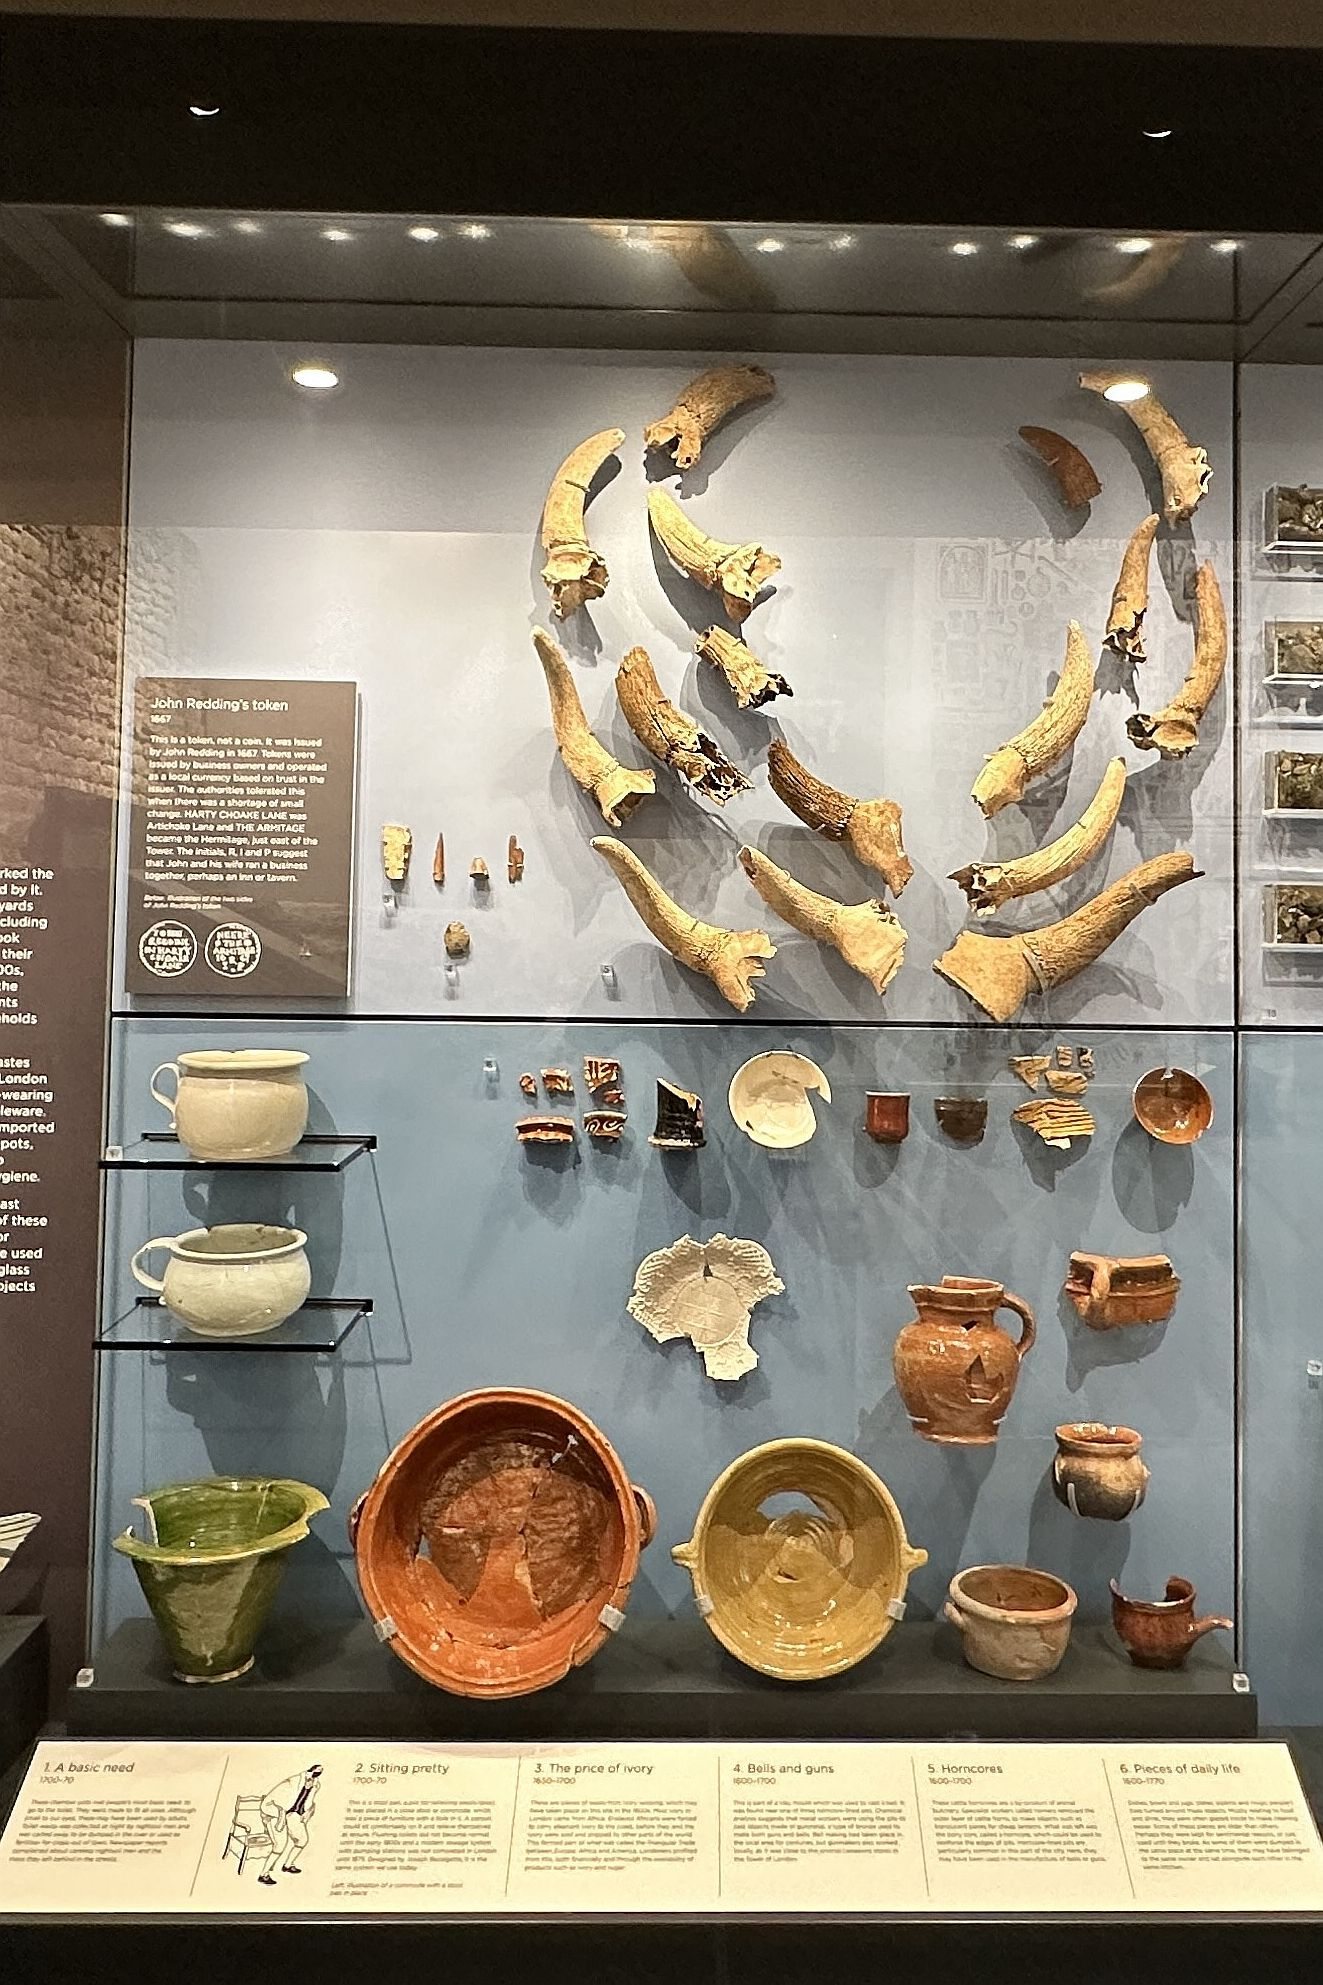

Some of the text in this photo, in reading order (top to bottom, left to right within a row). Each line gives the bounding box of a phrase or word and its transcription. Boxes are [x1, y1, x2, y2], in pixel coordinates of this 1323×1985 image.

[150, 697, 289, 712] John Redding's token
[150, 735, 169, 744] This
[170, 736, 178, 744] is
[217, 737, 233, 745] not
[294, 738, 322, 747] issued
[150, 748, 162, 758] by
[163, 748, 185, 757] John
[187, 748, 225, 758] Redding
[227, 749, 235, 757] in
[261, 750, 292, 759] Tokens
[149, 760, 177, 769] issued
[179, 761, 191, 770] by
[193, 761, 231, 770] business
[268, 763, 285, 771] and
[286, 763, 327, 772] operated
[169, 773, 190, 782] local
[192, 775, 231, 783] currency
[233, 774, 260, 783] based
[299, 775, 308, 784] in
[309, 775, 325, 784] the
[178, 785, 195, 794] The
[196, 786, 245, 795] authorities
[246, 787, 287, 795] tolerated
[288, 787, 305, 796] this
[148, 798, 173, 806] when
[174, 798, 198, 807] there
[227, 799, 267, 809] shortage
[269, 799, 279, 807] of
[280, 800, 304, 808] small
[185, 811, 217, 819] HARTY
[219, 811, 260, 820] CHOAKE
[262, 812, 288, 820] LANE
[147, 822, 305, 833] Artichoke Lane and THE ARMITAGE
[146, 834, 183, 843] became
[185, 835, 199, 844] the
[252, 836, 269, 845] just
[270, 837, 289, 845] east
[291, 837, 301, 845] of
[303, 837, 318, 845] the
[177, 847, 194, 856] The
[244, 848, 262, 857] and
[264, 848, 271, 856] P
[273, 850, 308, 858] suggest
[146, 859, 164, 867] that
[166, 860, 189, 868] John
[190, 860, 208, 868] and
[209, 860, 223, 869] his
[224, 860, 244, 869] wife
[270, 861, 308, 870] business
[0, 867, 54, 880] rked the
[187, 873, 224, 881] perhaps
[239, 873, 253, 881] inn
[255, 874, 265, 882] or
[11, 884, 28, 898] by
[0, 900, 34, 914] yards
[0, 916, 48, 930] cluding
[2, 948, 34, 960] their
[604, 965, 610, 974] 5
[0, 981, 19, 992] he
[0, 1013, 38, 1025] holds
[0, 1073, 48, 1085] London
[11, 1215, 48, 1227] these
[11, 1248, 43, 1259] used
[0, 1263, 30, 1278] glass
[54, 1762, 64, 1773] A
[68, 1762, 100, 1773] basic
[103, 1762, 135, 1773] need
[369, 1763, 409, 1774] Sitting
[412, 1764, 450, 1775] pretty
[535, 1763, 654, 1775] 3. The price of ivory
[748, 1764, 776, 1774] Bells
[779, 1764, 802, 1774] and
[805, 1764, 835, 1775] guns
[942, 1764, 1003, 1774] Horncores
[1134, 1764, 1172, 1774] Pieces
[1176, 1763, 1188, 1774] of
[1191, 1763, 1219, 1775] daily
[1222, 1763, 1241, 1774] life
